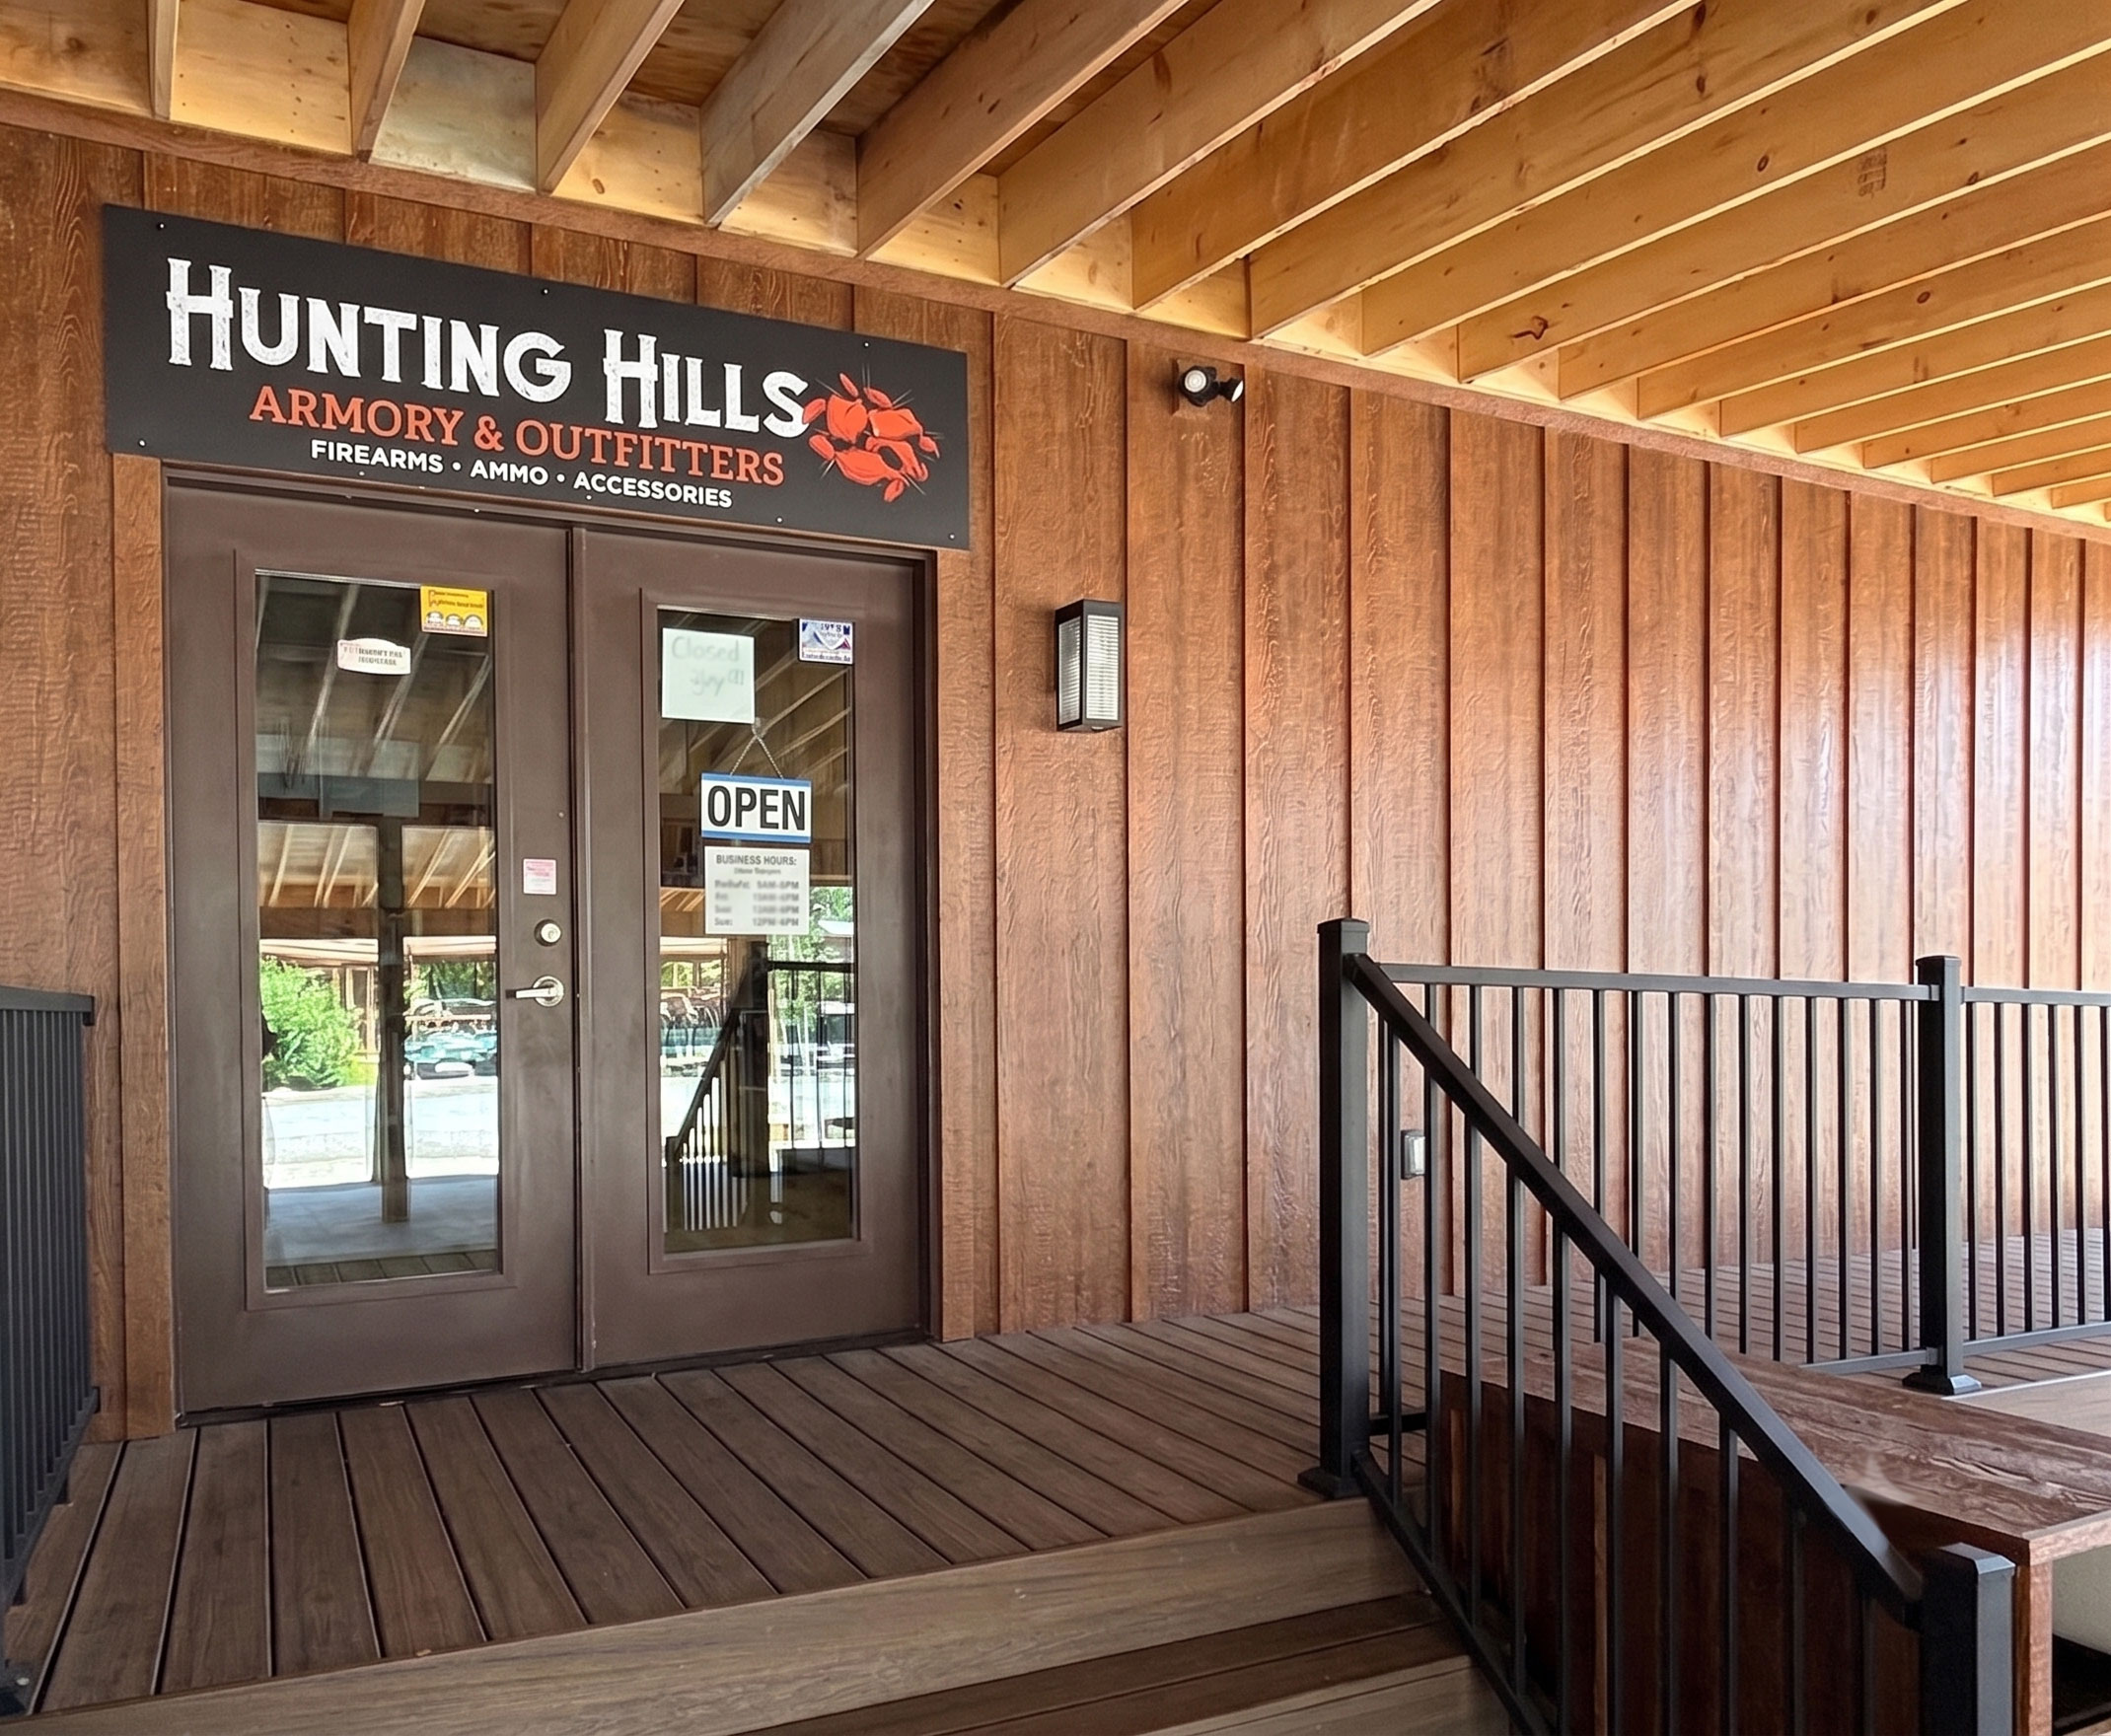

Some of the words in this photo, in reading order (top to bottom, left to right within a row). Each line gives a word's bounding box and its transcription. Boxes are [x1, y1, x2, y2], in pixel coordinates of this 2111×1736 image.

[166, 257, 572, 402] HUNTING
[603, 328, 810, 438] HILLS
[250, 386, 465, 447] ARMORY
[473, 414, 503, 453] &
[515, 420, 785, 487] OUTFITTERS
[310, 439, 445, 474] FIREARMS
[470, 460, 549, 485] AMMO
[573, 470, 734, 509] ACCESSORIES
[707, 785, 806, 832] OPEN
[716, 854, 762, 865] BUSINESS
[764, 855, 797, 866] HOURS:
